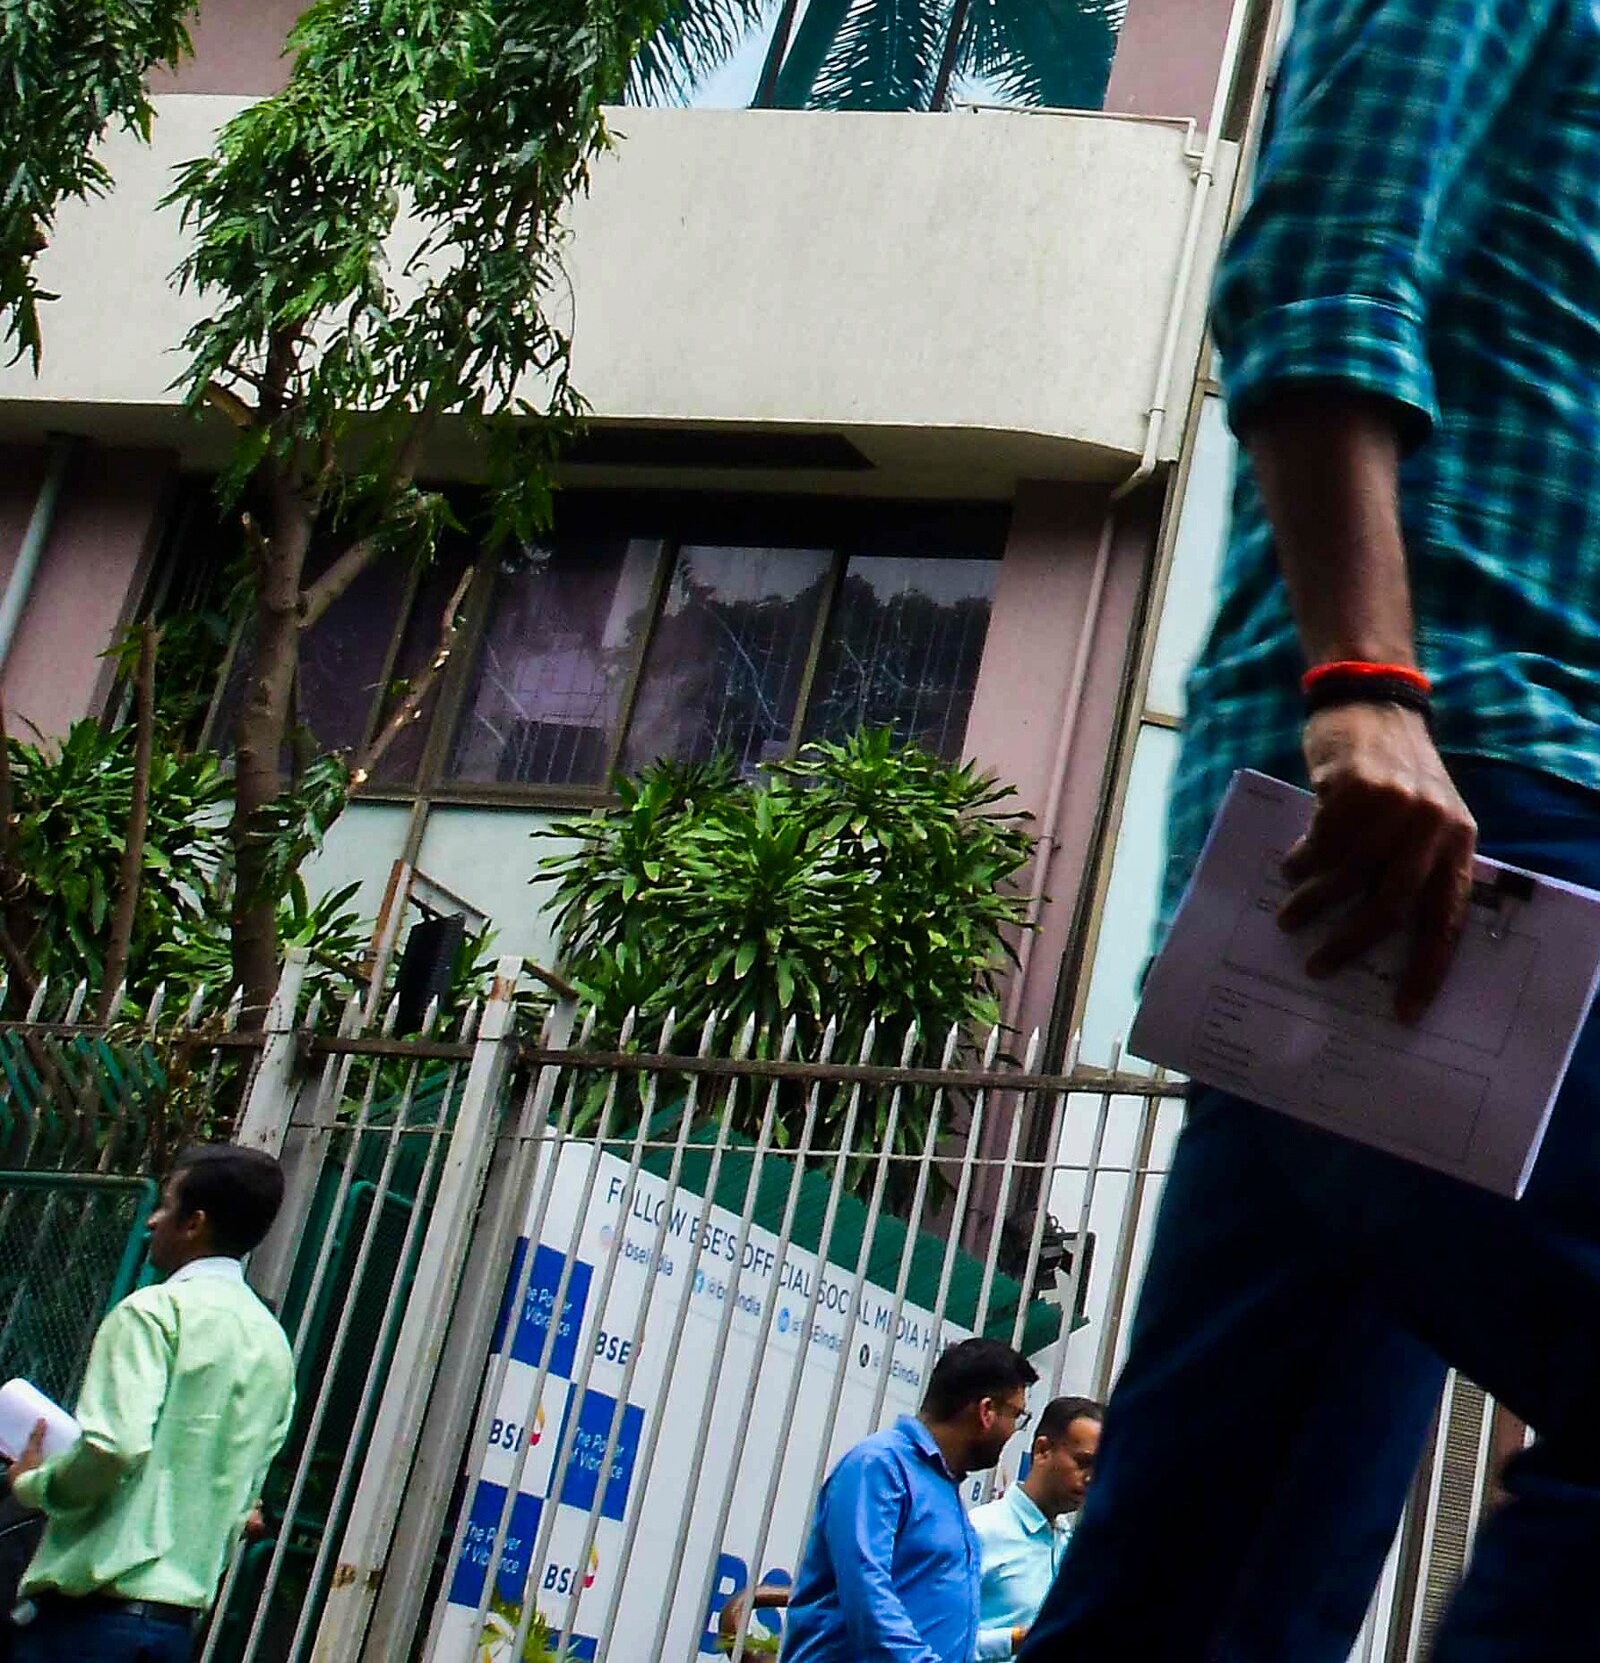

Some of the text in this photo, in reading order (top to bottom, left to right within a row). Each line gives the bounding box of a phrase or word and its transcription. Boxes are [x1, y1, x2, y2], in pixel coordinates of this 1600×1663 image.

[608, 1176, 688, 1238] FLLOW
[740, 1240, 811, 1298] OFFCIAL
[816, 1278, 870, 1326] SOCL
